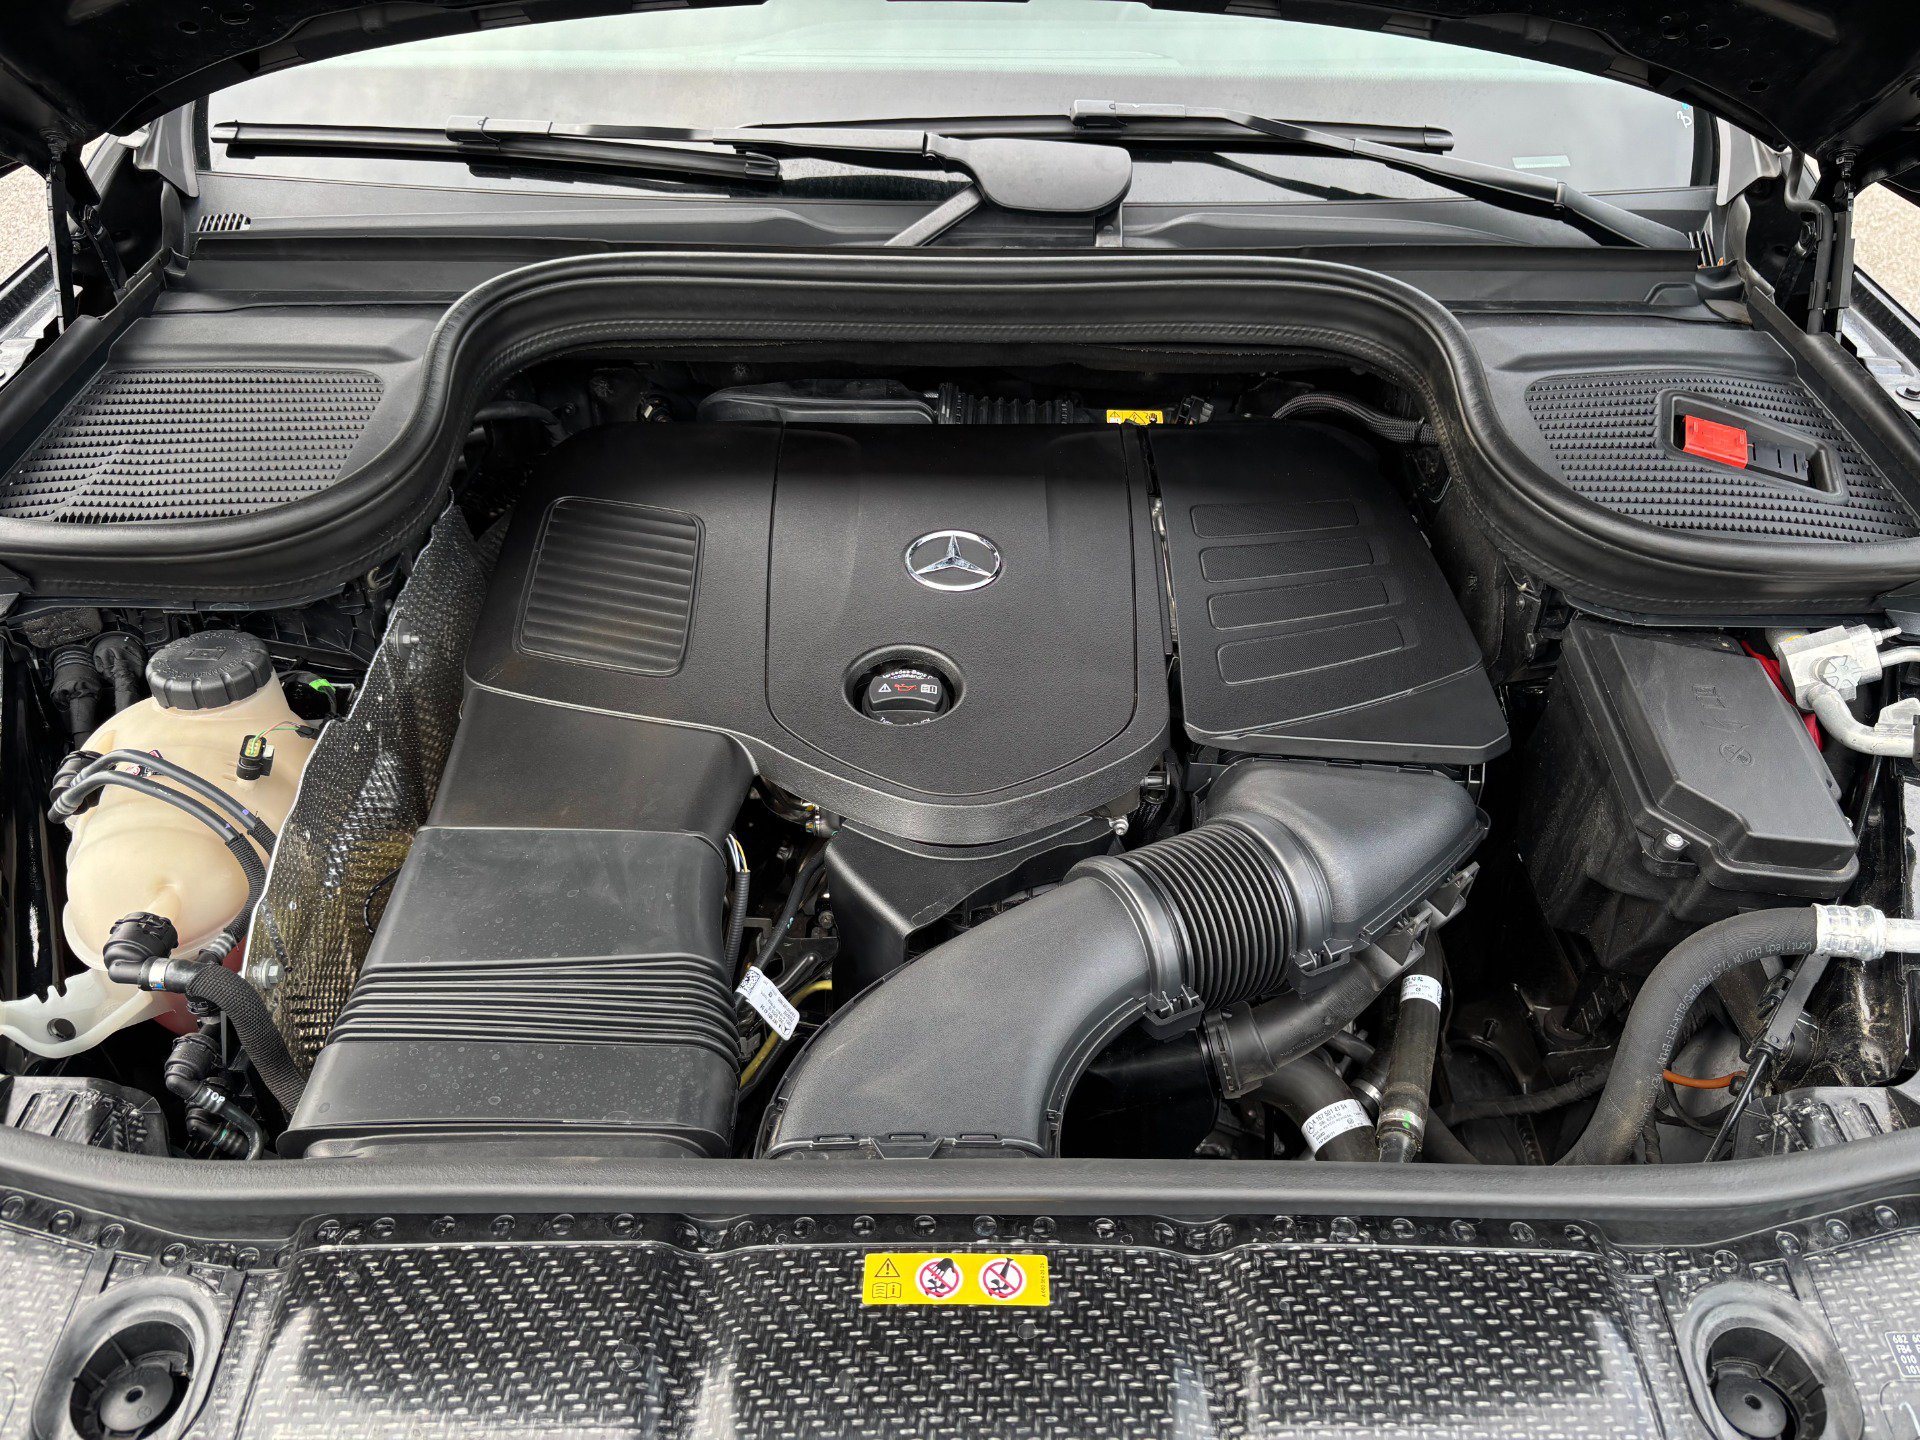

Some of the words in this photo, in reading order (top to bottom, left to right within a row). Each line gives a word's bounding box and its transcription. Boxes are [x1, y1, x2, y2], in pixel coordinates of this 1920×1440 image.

[206, 1087, 226, 1104] TOP
[1893, 1334, 1908, 1344] 682
[1896, 1344, 1912, 1354] FB4
[1900, 1355, 1917, 1364] 010
